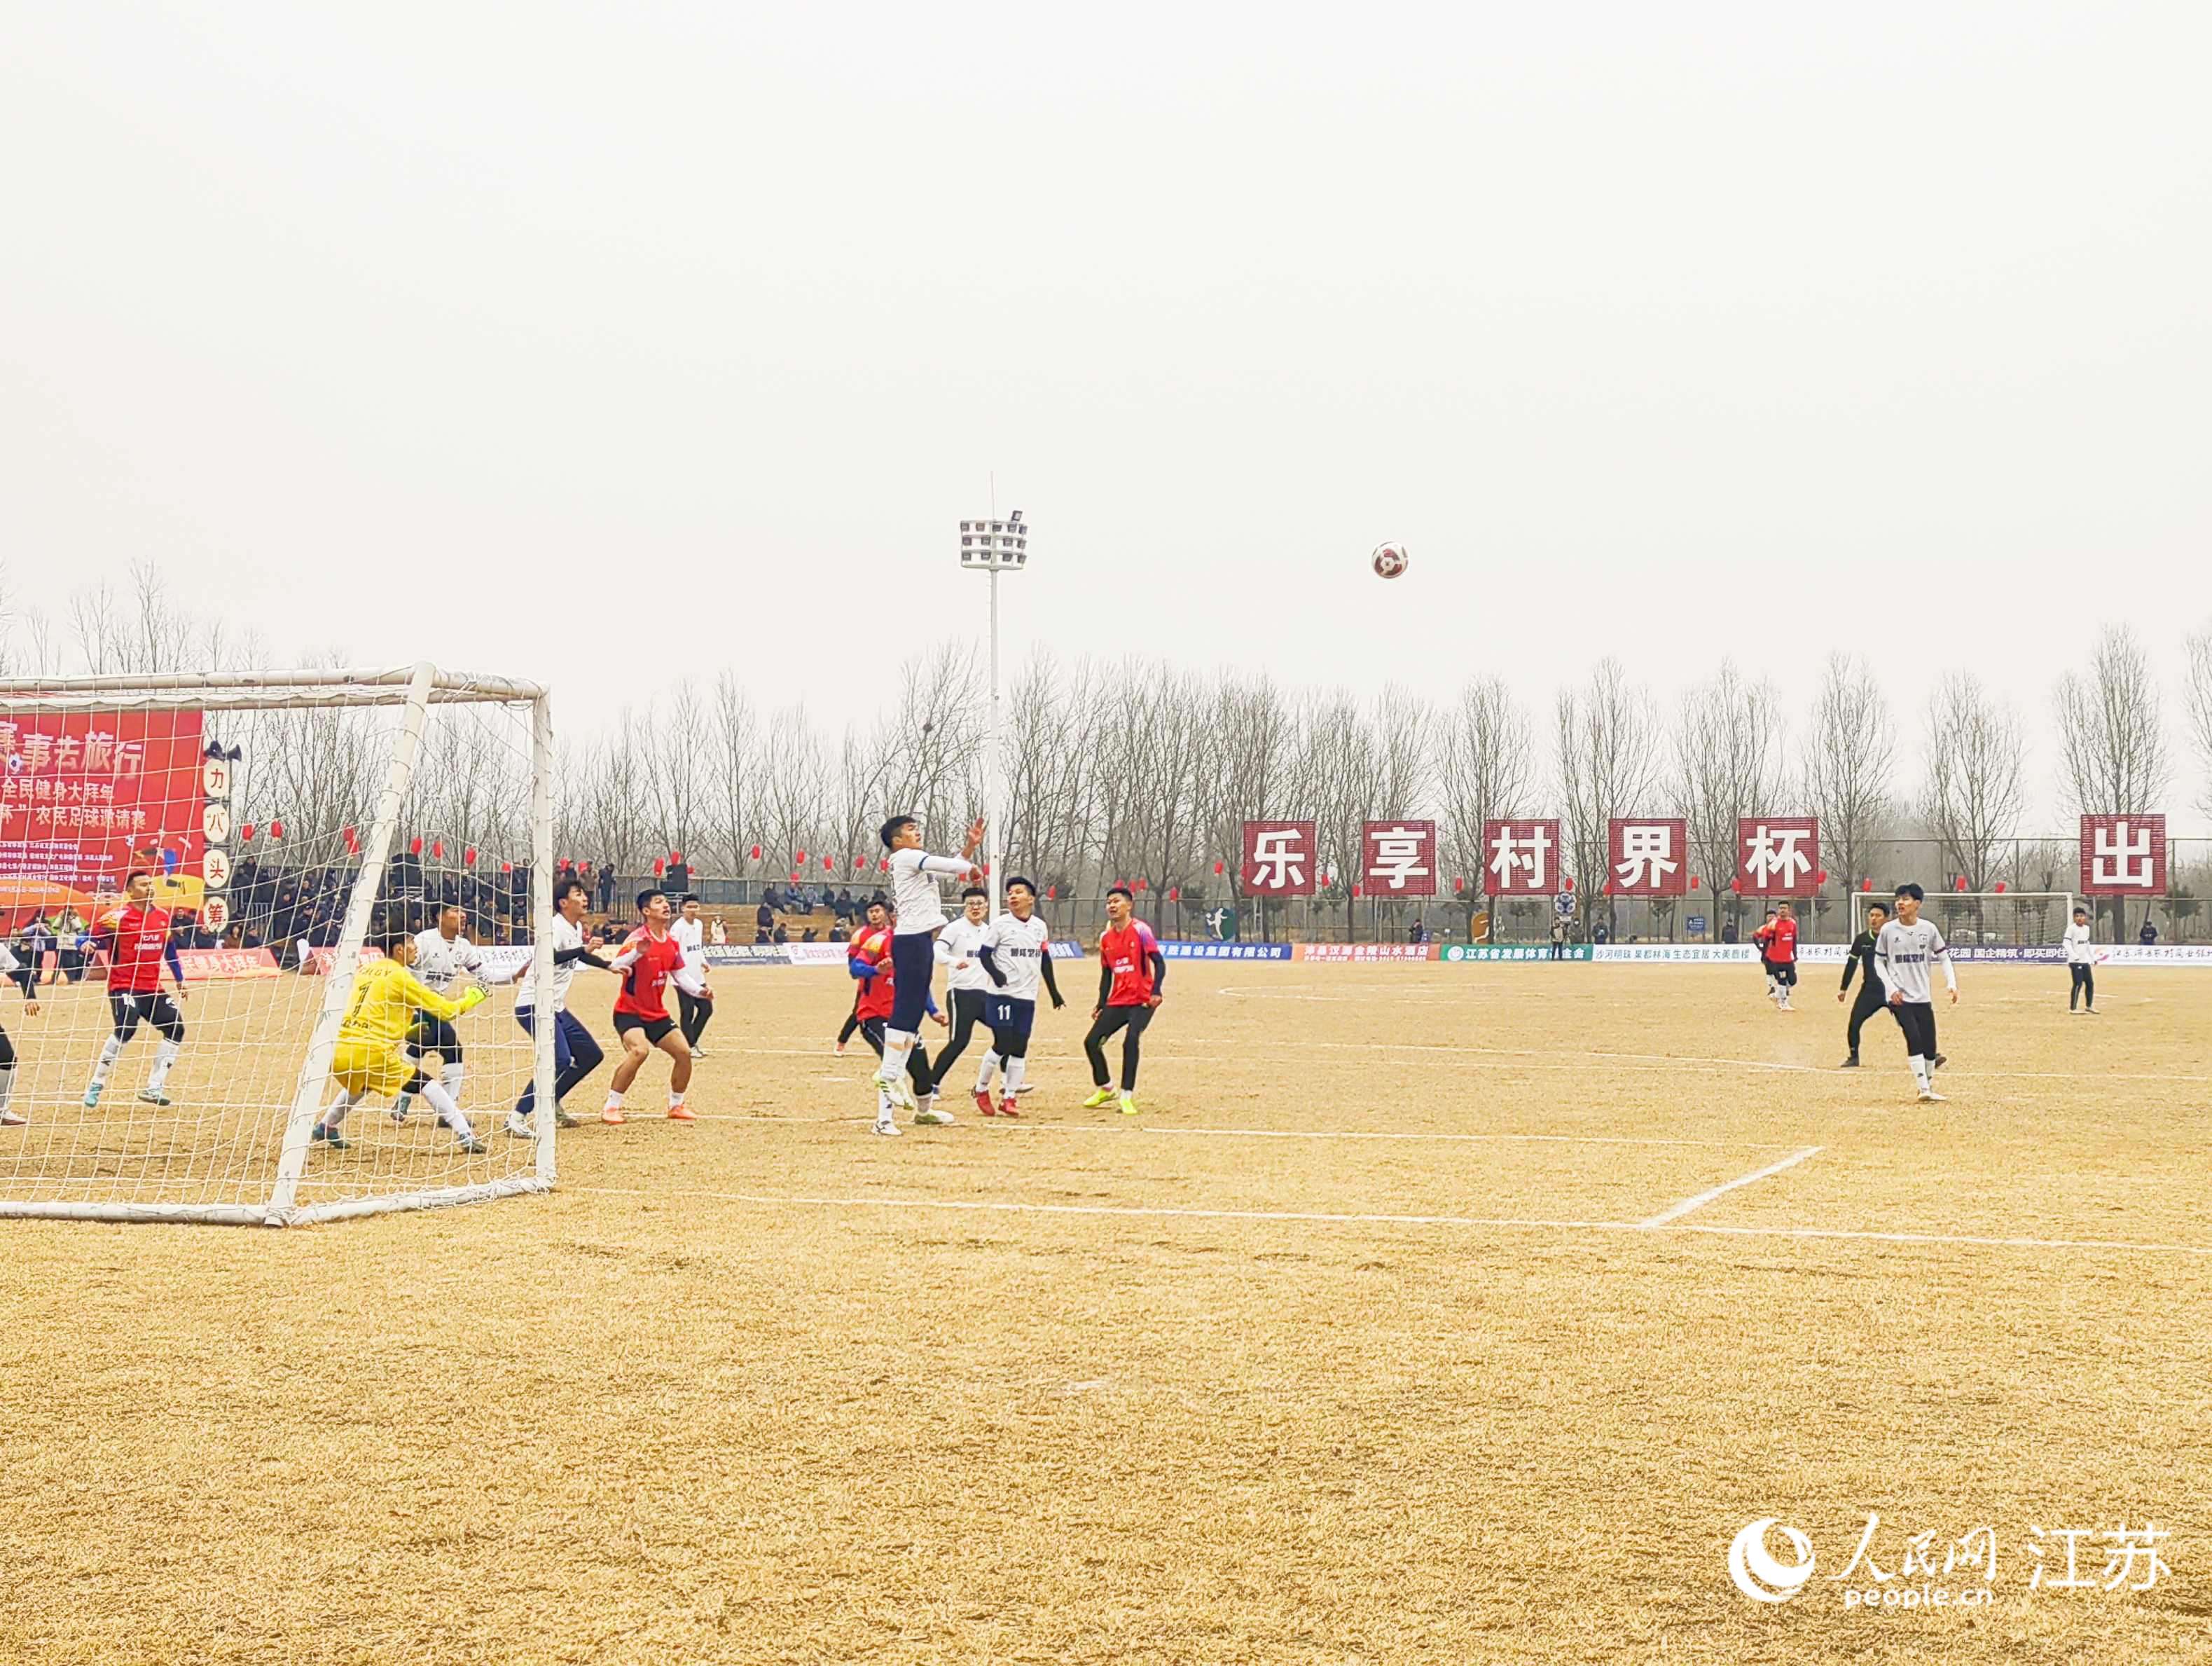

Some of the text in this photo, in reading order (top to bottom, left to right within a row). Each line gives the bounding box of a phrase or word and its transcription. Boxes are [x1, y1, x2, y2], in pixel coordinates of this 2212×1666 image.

[1, 776, 115, 804] 全民健身大拜年
[1252, 825, 1810, 890] 乐享村界杯
[2092, 821, 2153, 887] 出
[997, 1005, 1011, 1020] 11
